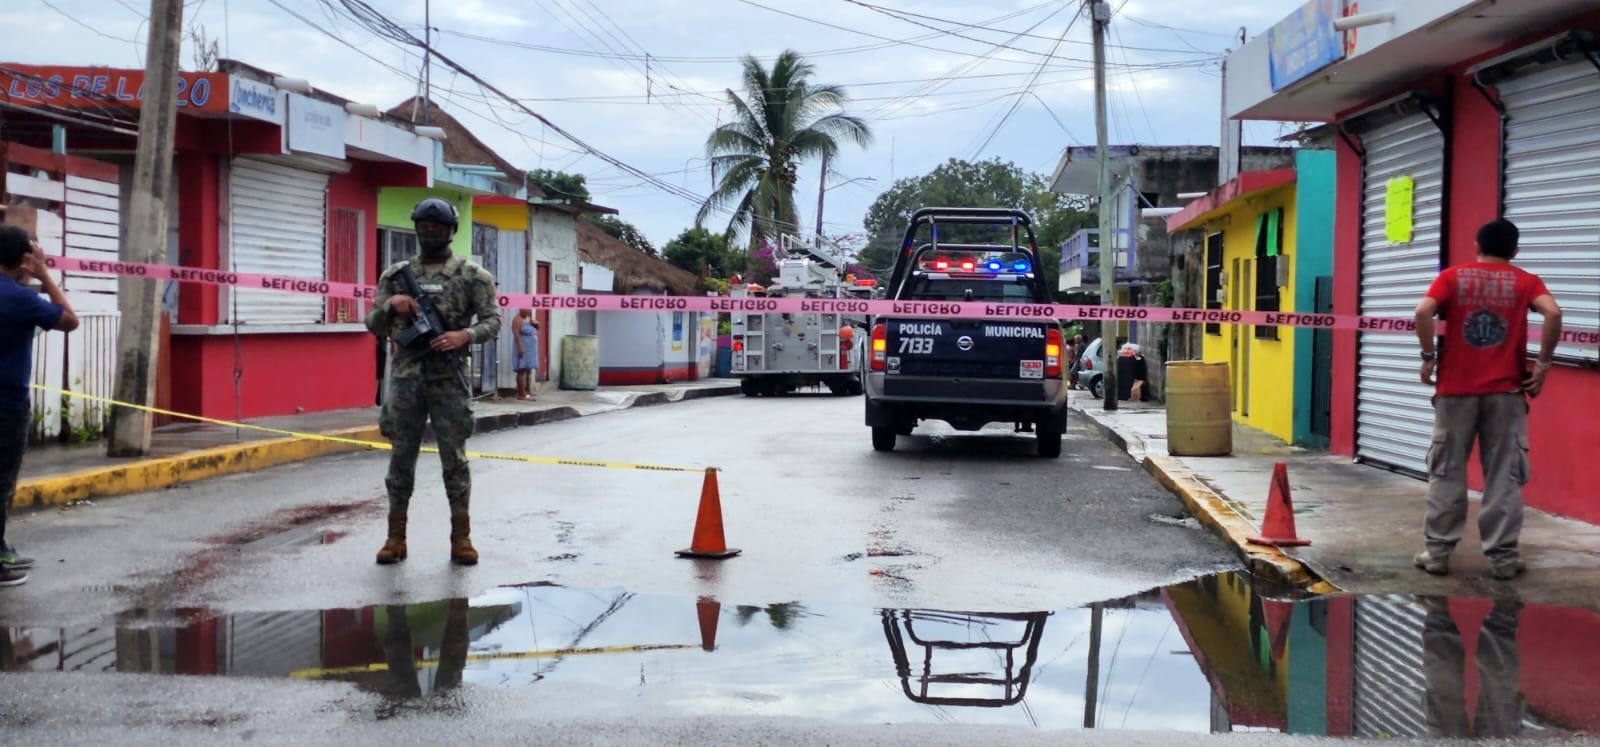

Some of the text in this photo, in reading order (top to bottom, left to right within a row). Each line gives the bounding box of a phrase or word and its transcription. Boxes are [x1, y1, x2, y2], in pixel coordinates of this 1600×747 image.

[9, 75, 64, 99] LOS
[72, 75, 110, 100] DE
[1456, 268, 1517, 280] COZUMEL
[1457, 277, 1516, 298] FIRE
[899, 322, 1045, 339] POLICÍA MUNICIPAL
[898, 337, 934, 354] 7133
